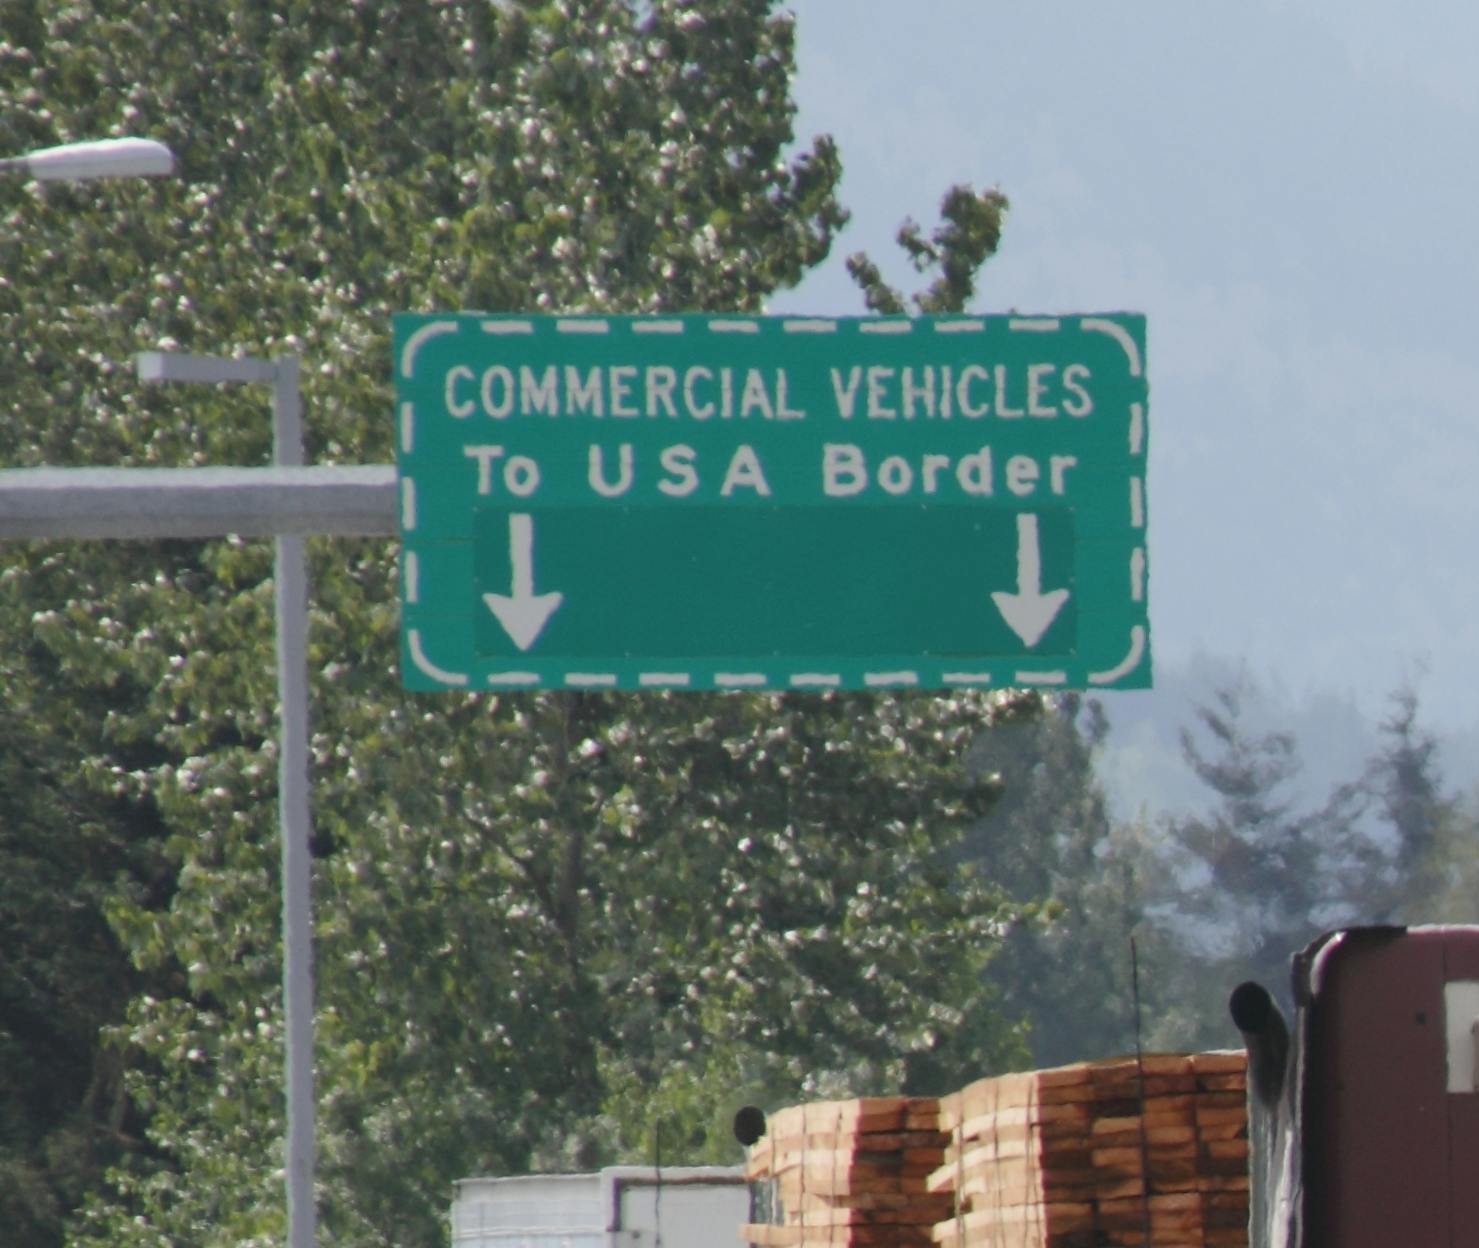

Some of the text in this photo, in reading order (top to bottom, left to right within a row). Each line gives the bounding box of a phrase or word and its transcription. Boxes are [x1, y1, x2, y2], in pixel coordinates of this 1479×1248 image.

[445, 362, 1094, 420] COMMERCIAL VEHICLES
[463, 445, 541, 497] To
[822, 441, 1078, 498] Border
